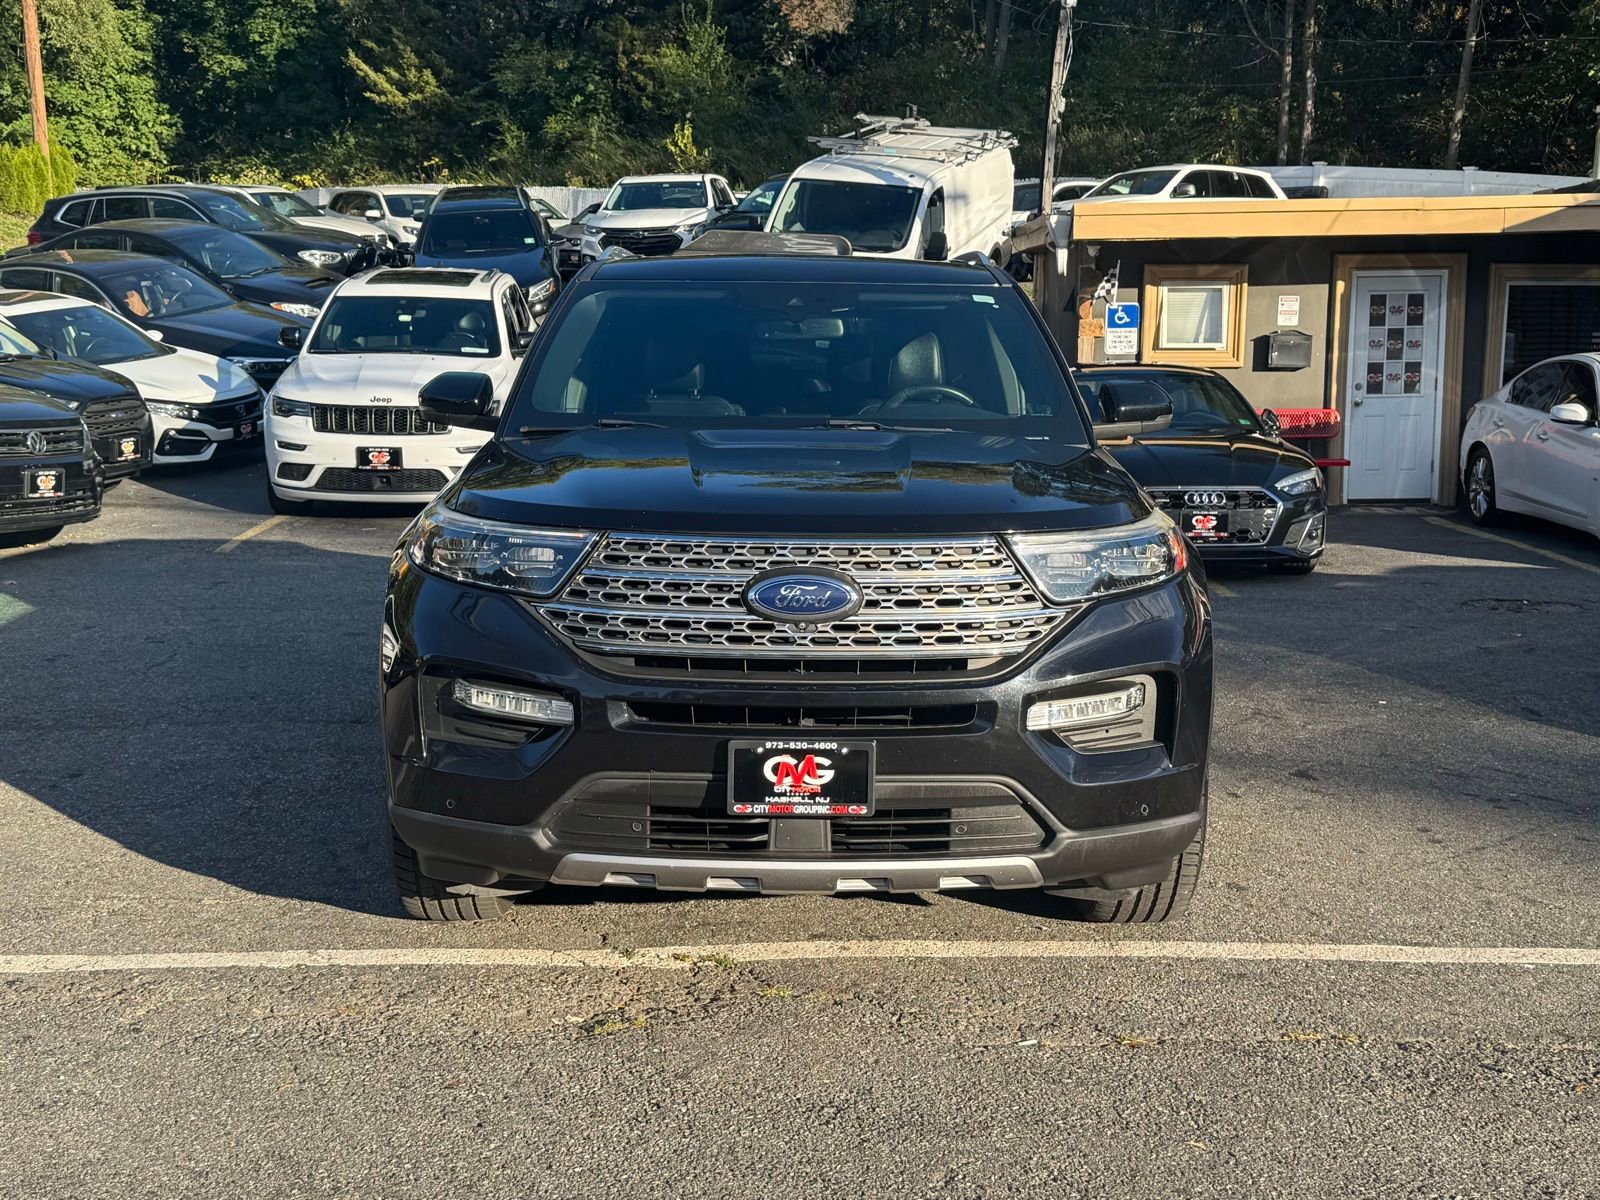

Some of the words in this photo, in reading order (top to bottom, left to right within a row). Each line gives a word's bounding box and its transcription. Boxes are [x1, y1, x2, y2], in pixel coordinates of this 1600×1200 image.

[370, 395, 392, 404] Jeep
[774, 584, 832, 608] Ford
[765, 741, 838, 750] 973-530-4600
[765, 796, 814, 804] HASKELL,
